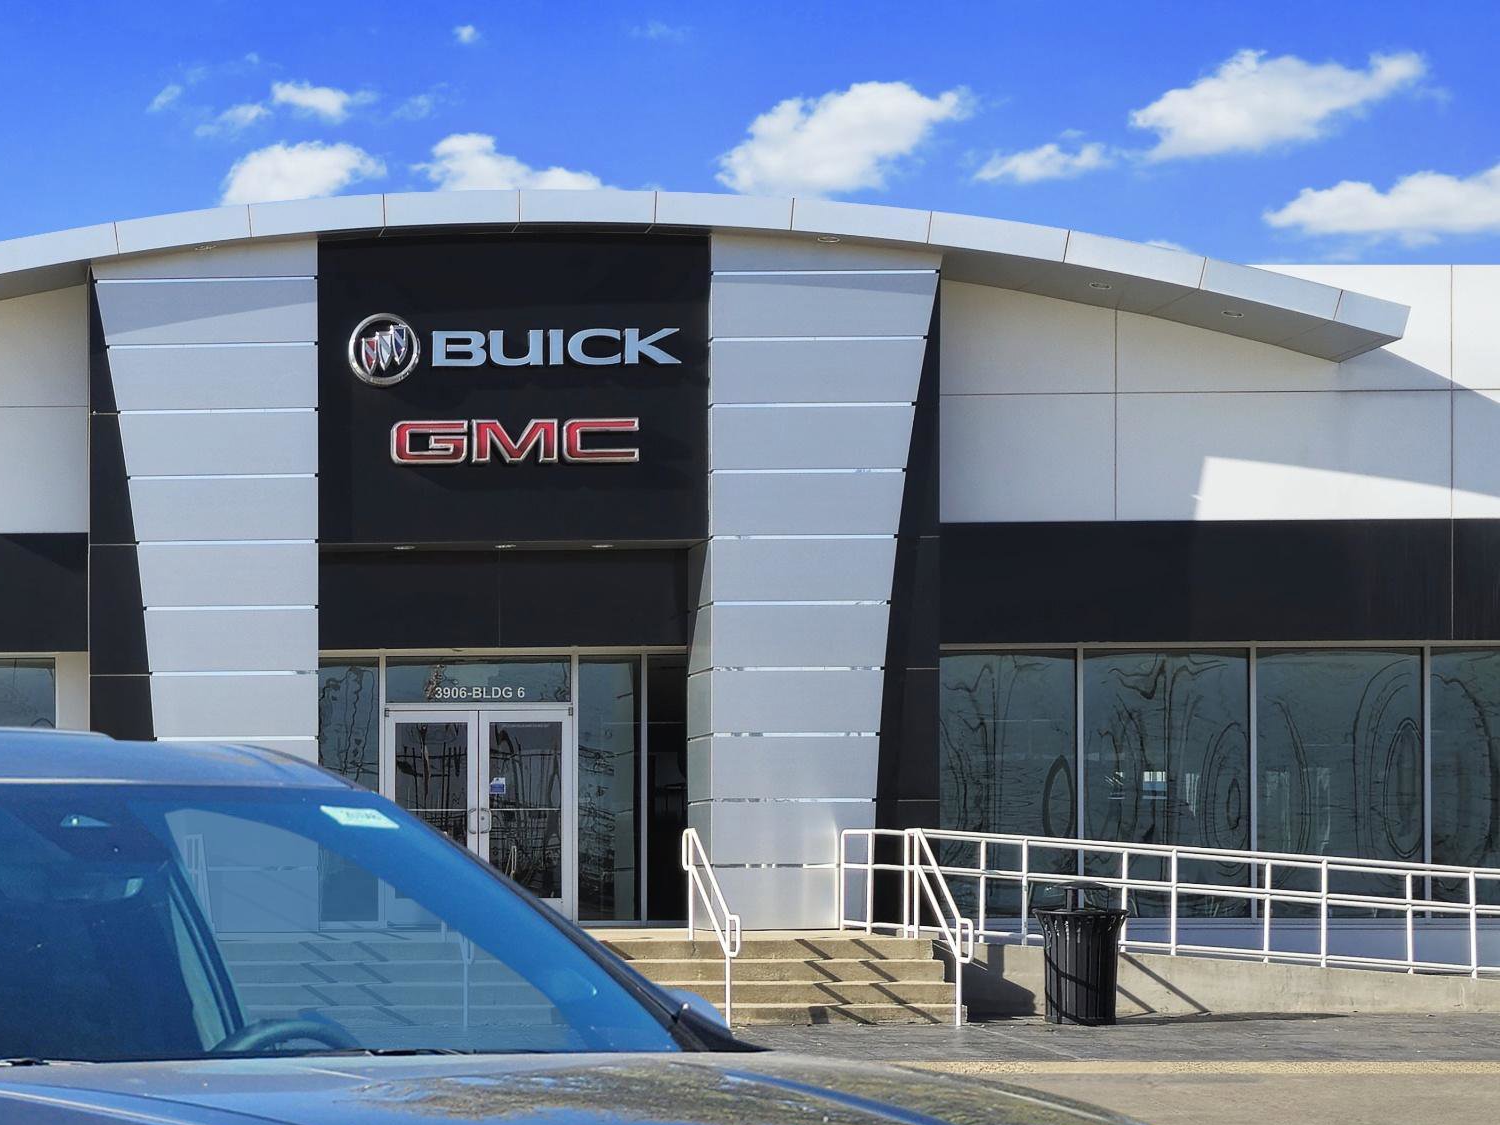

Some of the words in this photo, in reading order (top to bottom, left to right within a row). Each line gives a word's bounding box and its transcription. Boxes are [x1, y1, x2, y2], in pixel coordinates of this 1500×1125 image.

[432, 328, 682, 366] BUICK
[390, 417, 639, 463] GMC
[435, 687, 512, 698] 3906-BLDG
[517, 687, 526, 698] 6
